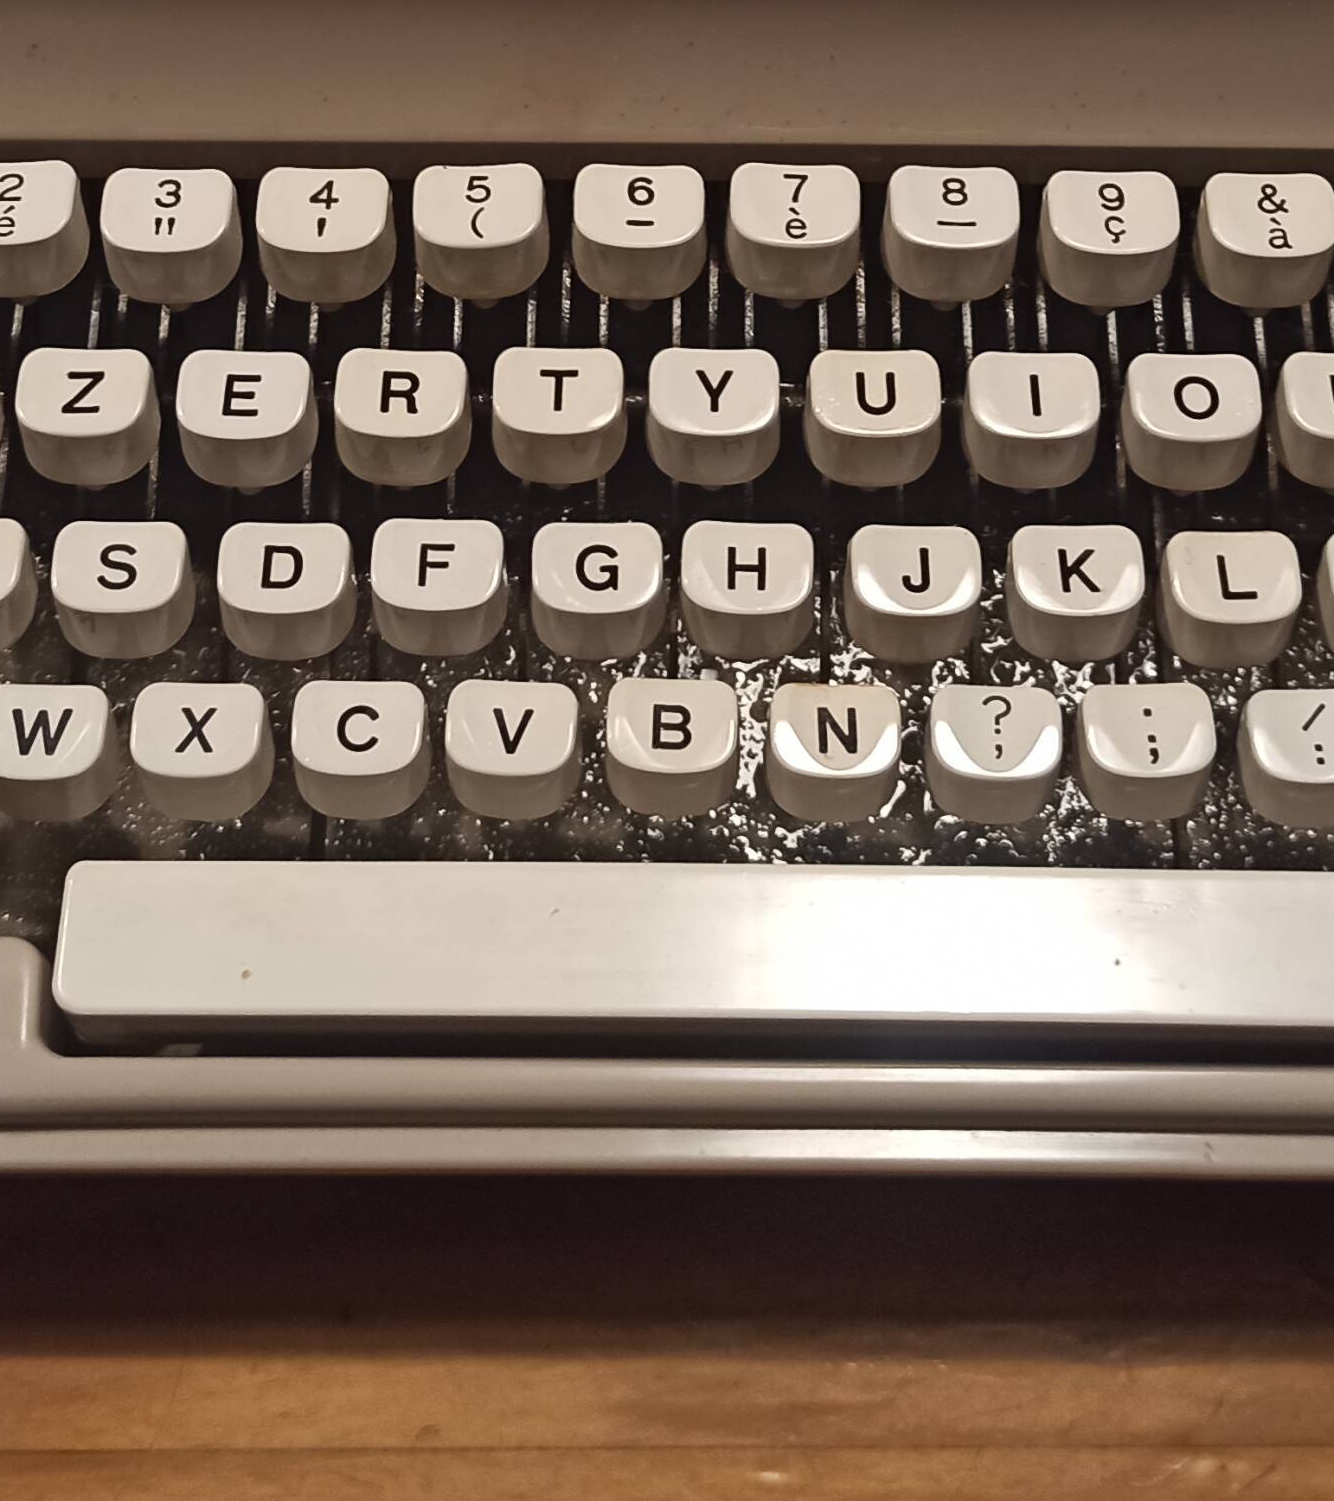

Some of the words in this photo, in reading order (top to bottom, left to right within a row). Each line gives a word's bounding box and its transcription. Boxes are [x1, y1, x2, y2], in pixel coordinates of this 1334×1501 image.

[155, 180, 181, 208] 3
[310, 181, 339, 209] 4
[466, 176, 491, 203] 5
[628, 177, 654, 205] 6
[784, 174, 808, 202] 7
[943, 178, 968, 205] 8
[1099, 184, 1124, 211] 9
[1258, 184, 1288, 214] &
[471, 207, 484, 238] (
[786, 208, 806, 239] è
[1105, 216, 1126, 243] ç
[1269, 218, 1292, 249] à
[62, 371, 104, 413] Z
[222, 374, 261, 416] E
[380, 371, 419, 414] R
[540, 370, 578, 411] T
[696, 370, 733, 412] Y
[856, 372, 896, 415] U
[1030, 375, 1041, 416] I
[1174, 376, 1219, 420] O
[97, 544, 137, 589] S
[261, 545, 303, 589] D
[418, 544, 455, 586] F
[576, 545, 618, 591] G
[728, 547, 766, 590] H
[902, 548, 930, 593] J
[1058, 549, 1100, 592] K
[1217, 555, 1257, 600] L
[12, 709, 73, 755] W
[175, 708, 217, 753] X
[337, 706, 379, 752] C
[493, 708, 534, 754] V
[652, 704, 691, 750] B
[818, 707, 857, 754] N
[982, 696, 1011, 734] ?
[1302, 704, 1325, 731] /
[1148, 735, 1159, 764] ;
[1315, 744, 1325, 764] :
